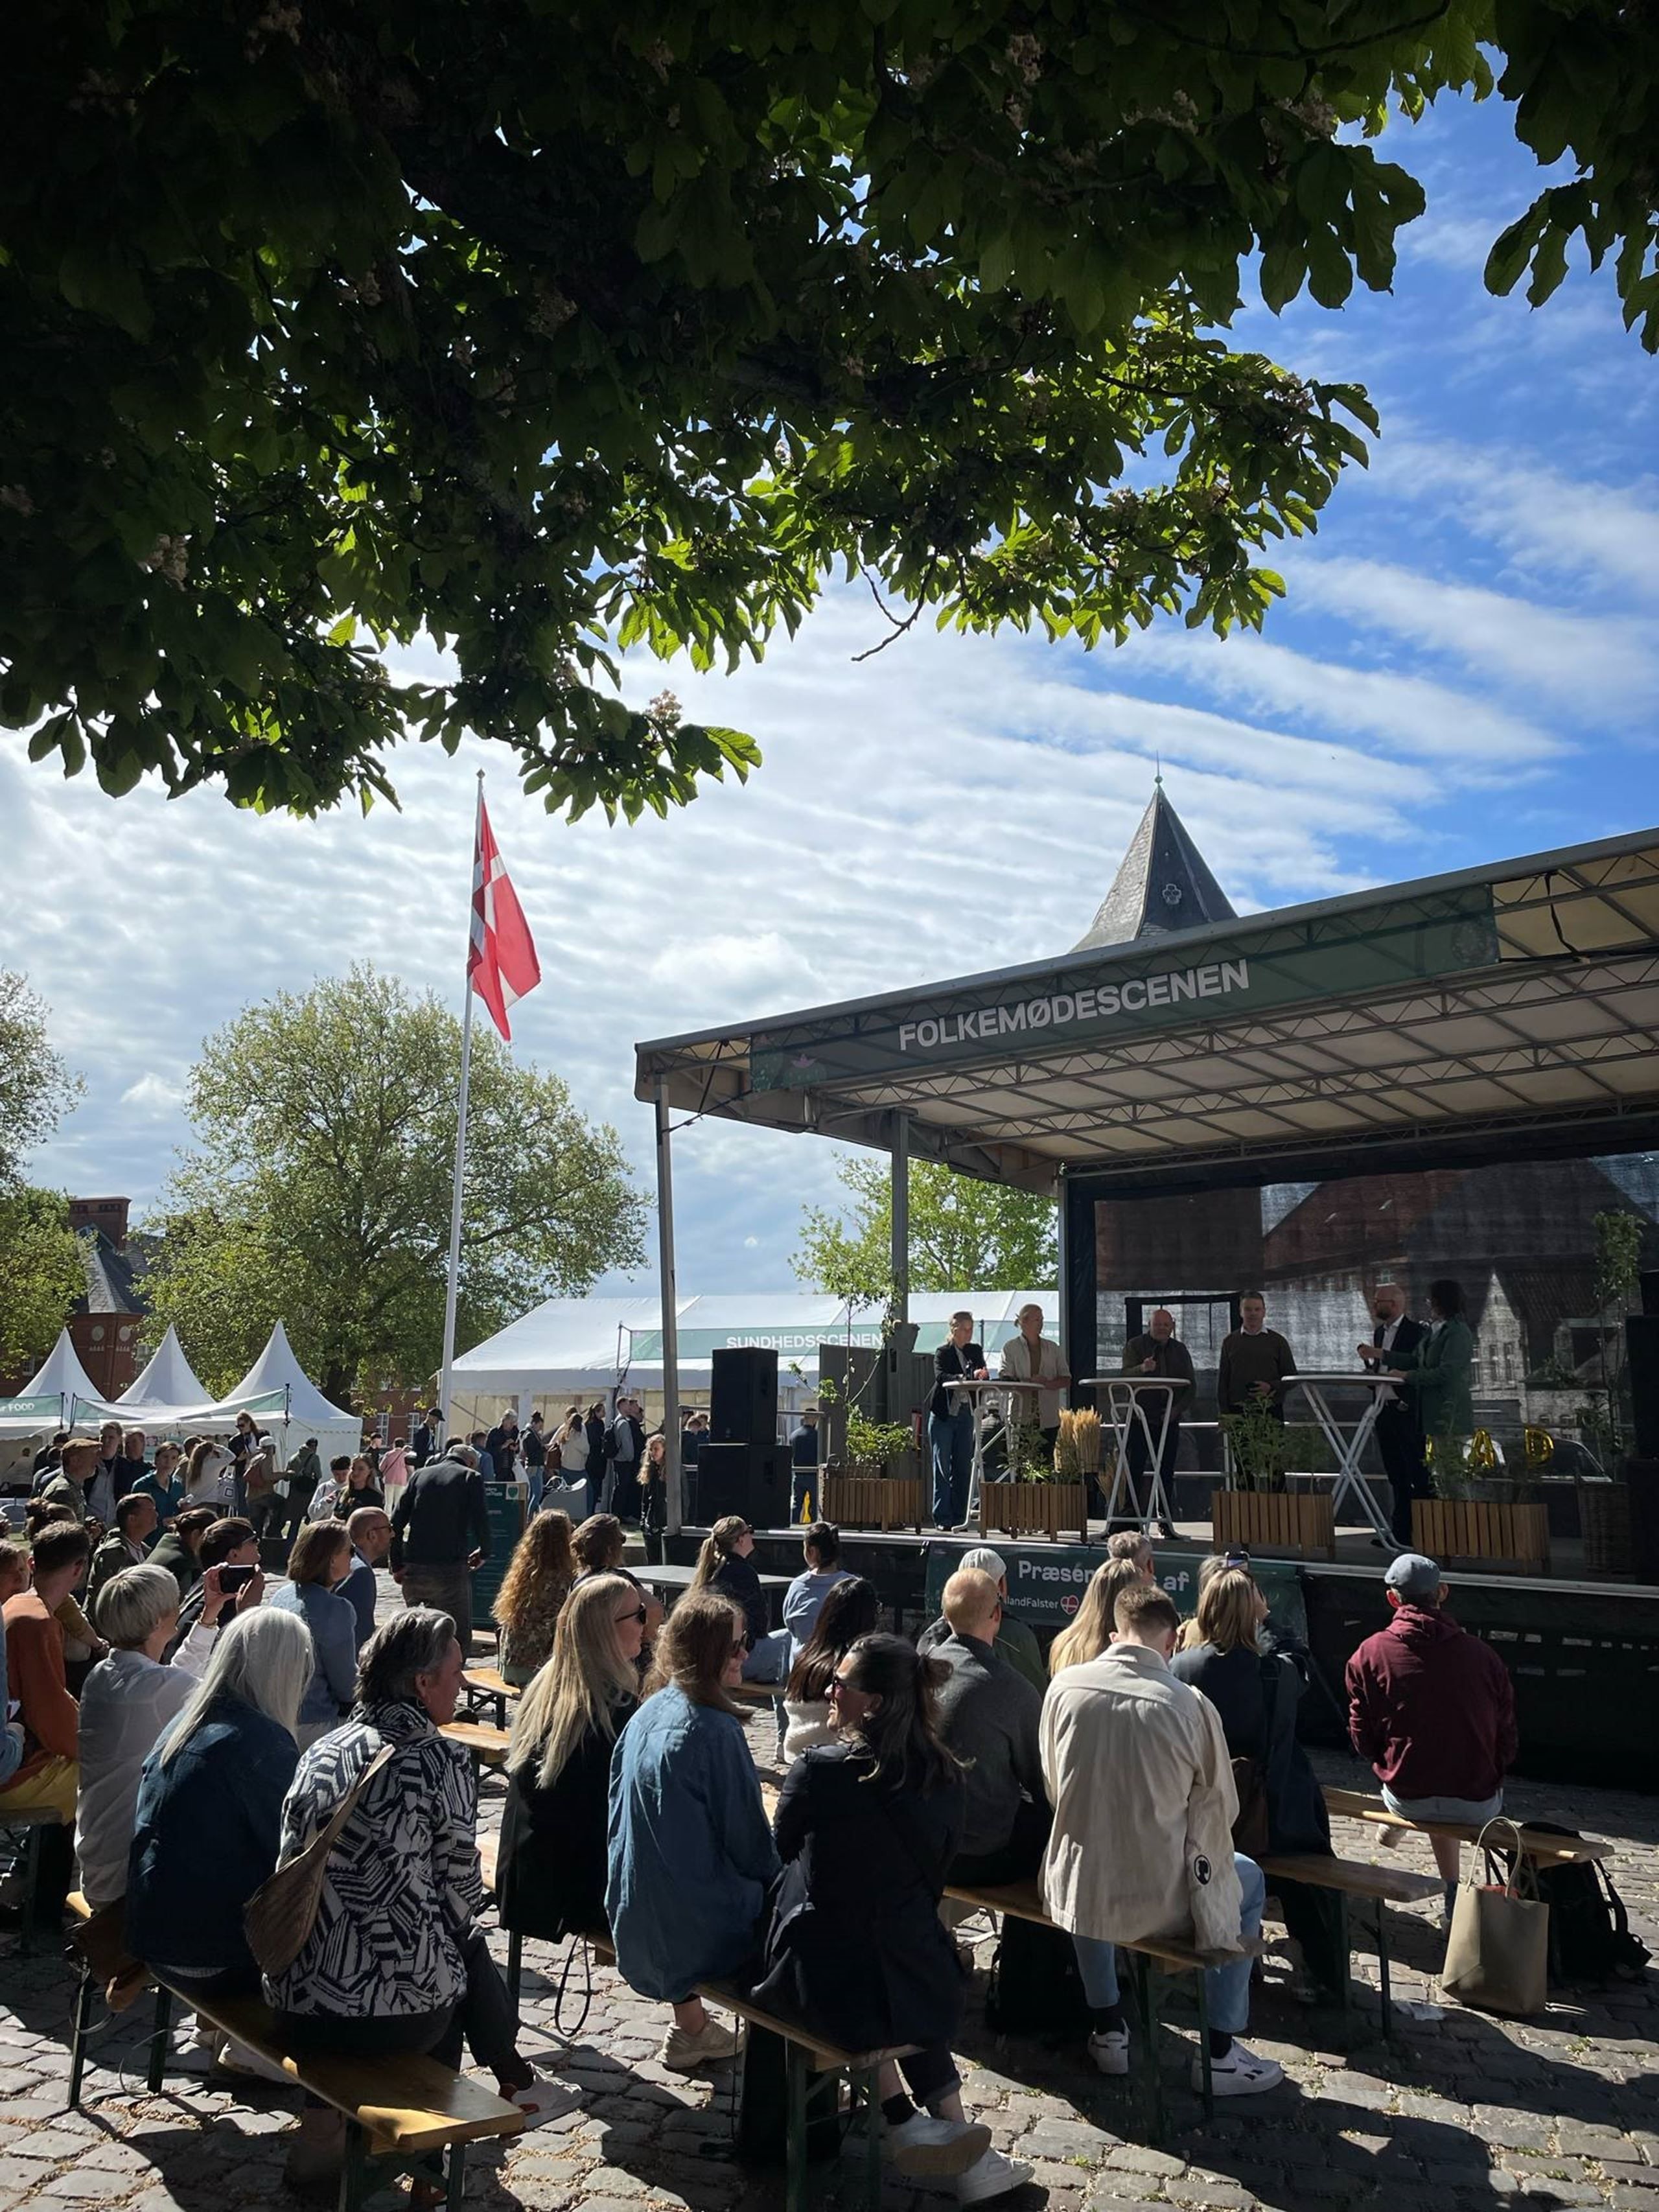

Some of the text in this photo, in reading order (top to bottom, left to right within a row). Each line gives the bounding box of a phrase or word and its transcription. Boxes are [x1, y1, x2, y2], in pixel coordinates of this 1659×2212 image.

[900, 959, 1250, 1051] FOLKEMØDESCENEN
[8, 1403, 35, 1412] FOOD
[1163, 1571, 1190, 1592] af
[1007, 1595, 1059, 1609] landFalster
